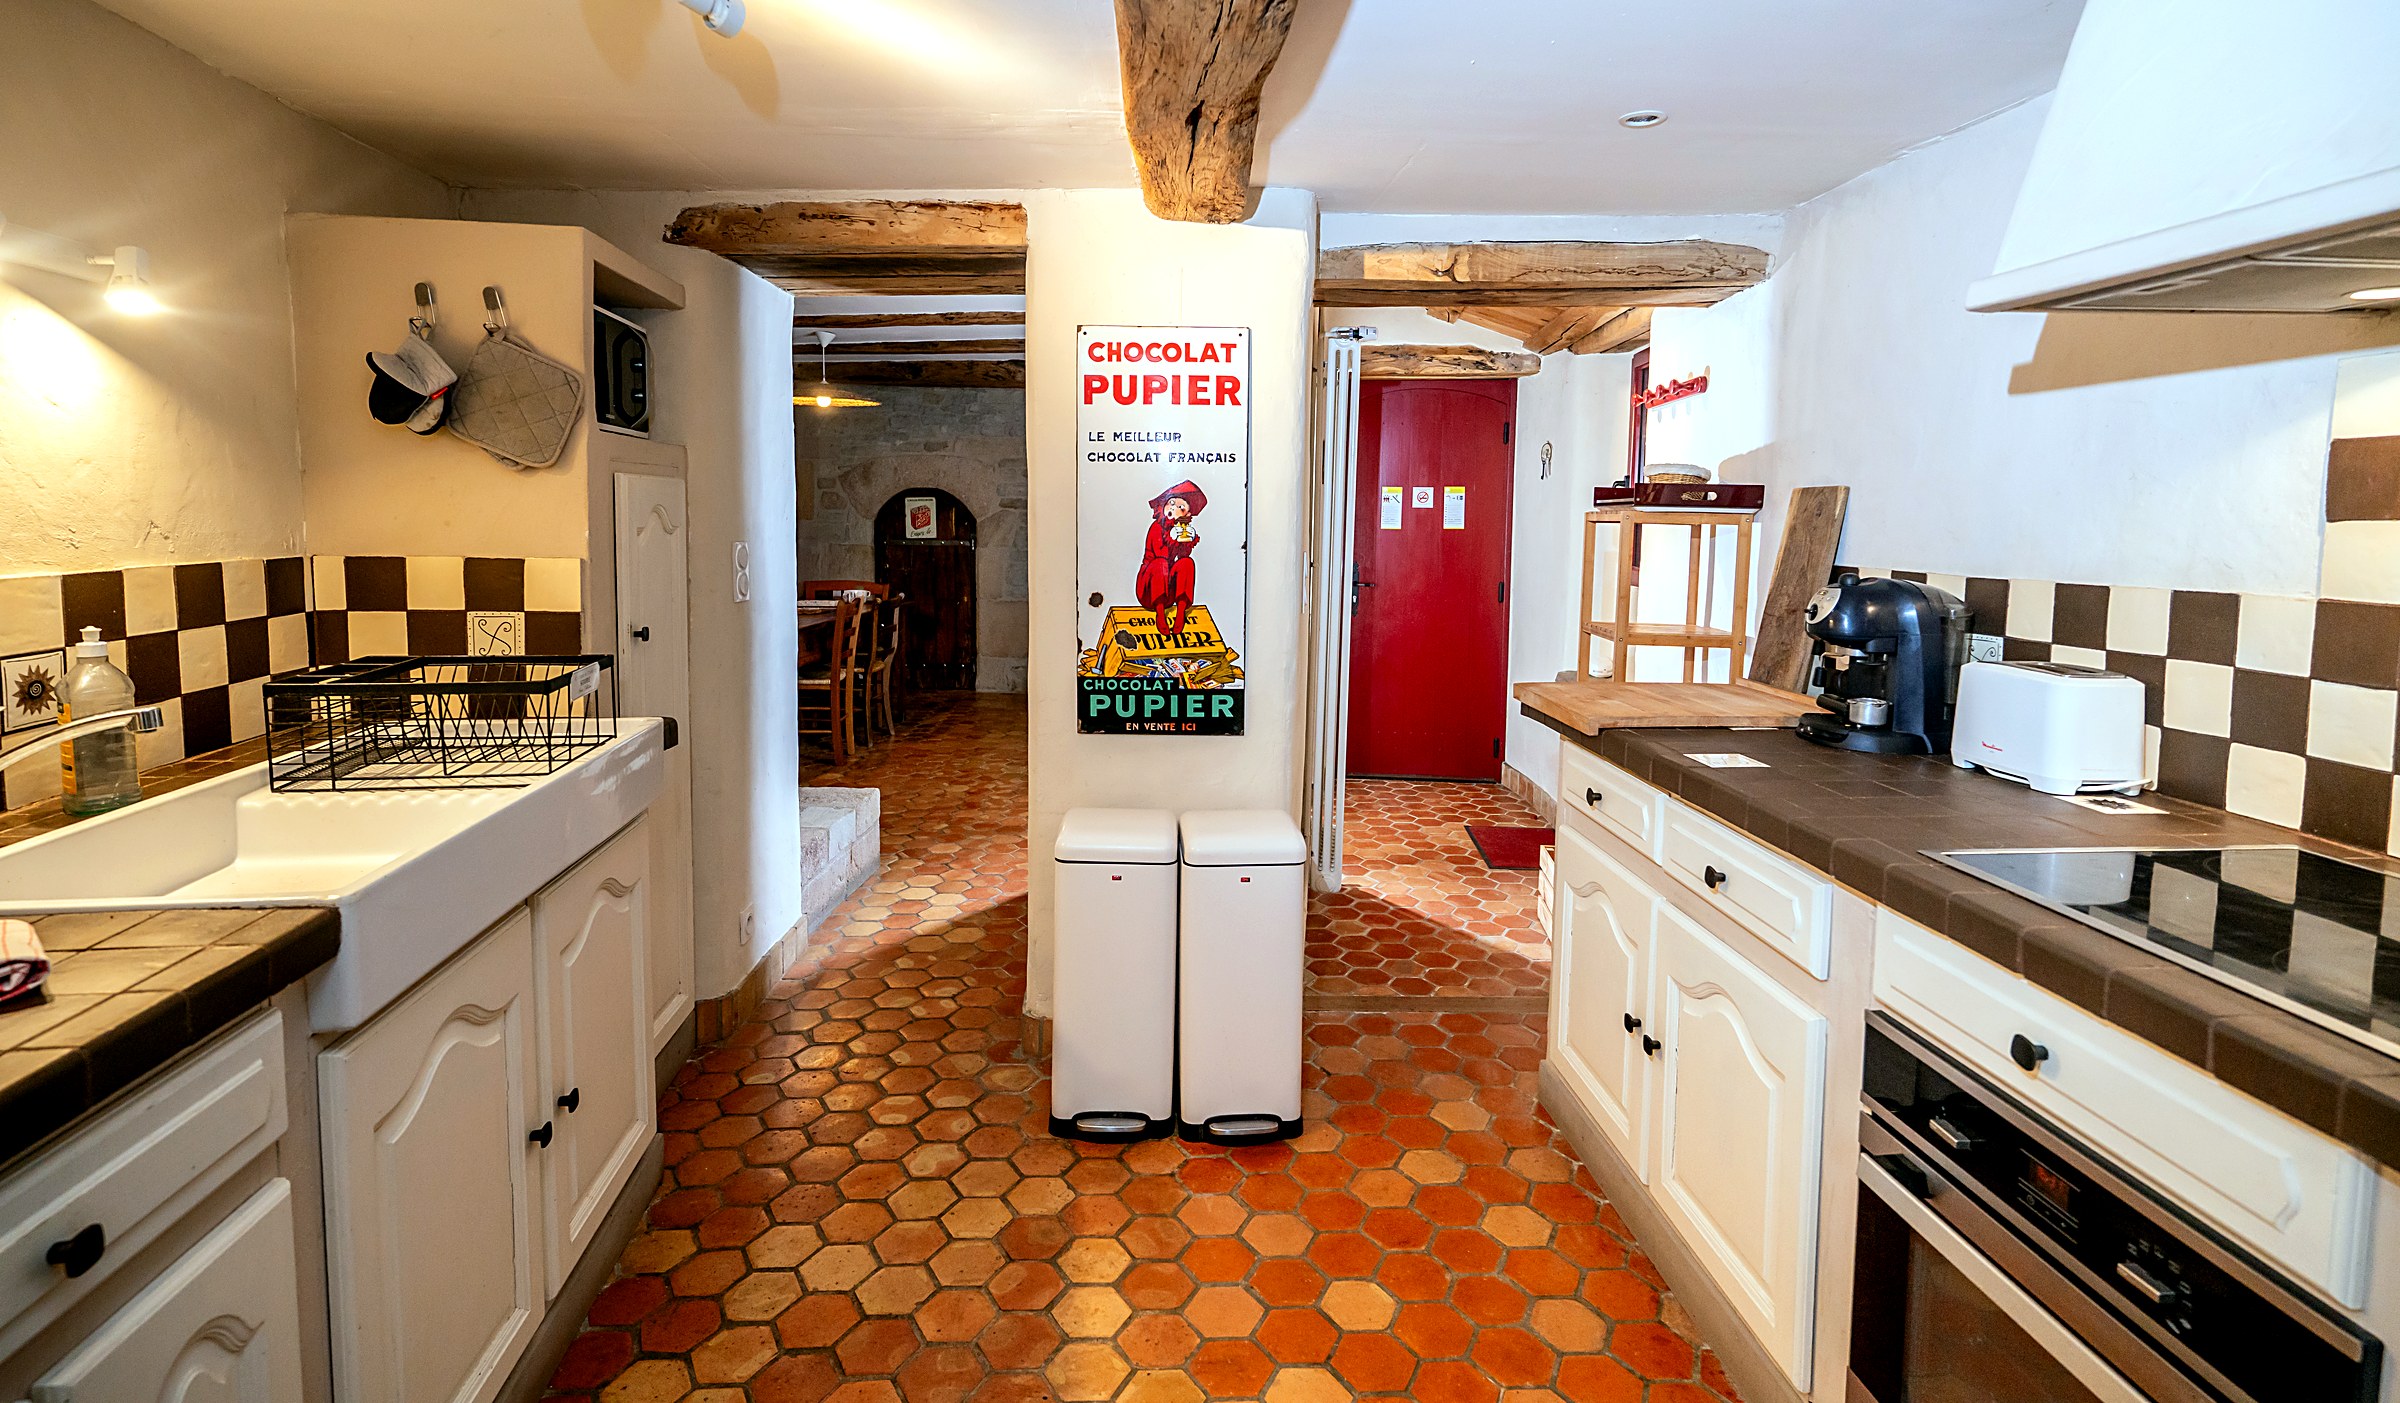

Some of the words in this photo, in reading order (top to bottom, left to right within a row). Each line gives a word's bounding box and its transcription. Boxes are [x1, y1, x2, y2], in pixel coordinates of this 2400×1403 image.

[1088, 342, 1237, 363] CHOCOLAT
[1084, 375, 1241, 405] PUPIER
[1088, 432, 1105, 442] LE
[1113, 432, 1182, 442] MEILLEUR
[1087, 452, 1161, 463] CHOCOLAT
[1168, 453, 1237, 464] FRANÇAIS
[1083, 679, 1173, 690] CHOCOLAT
[1089, 694, 1234, 717] PUPIER
[1126, 723, 1139, 731] EN
[1144, 723, 1176, 731] VENTE
[1182, 723, 1196, 731] ICI
